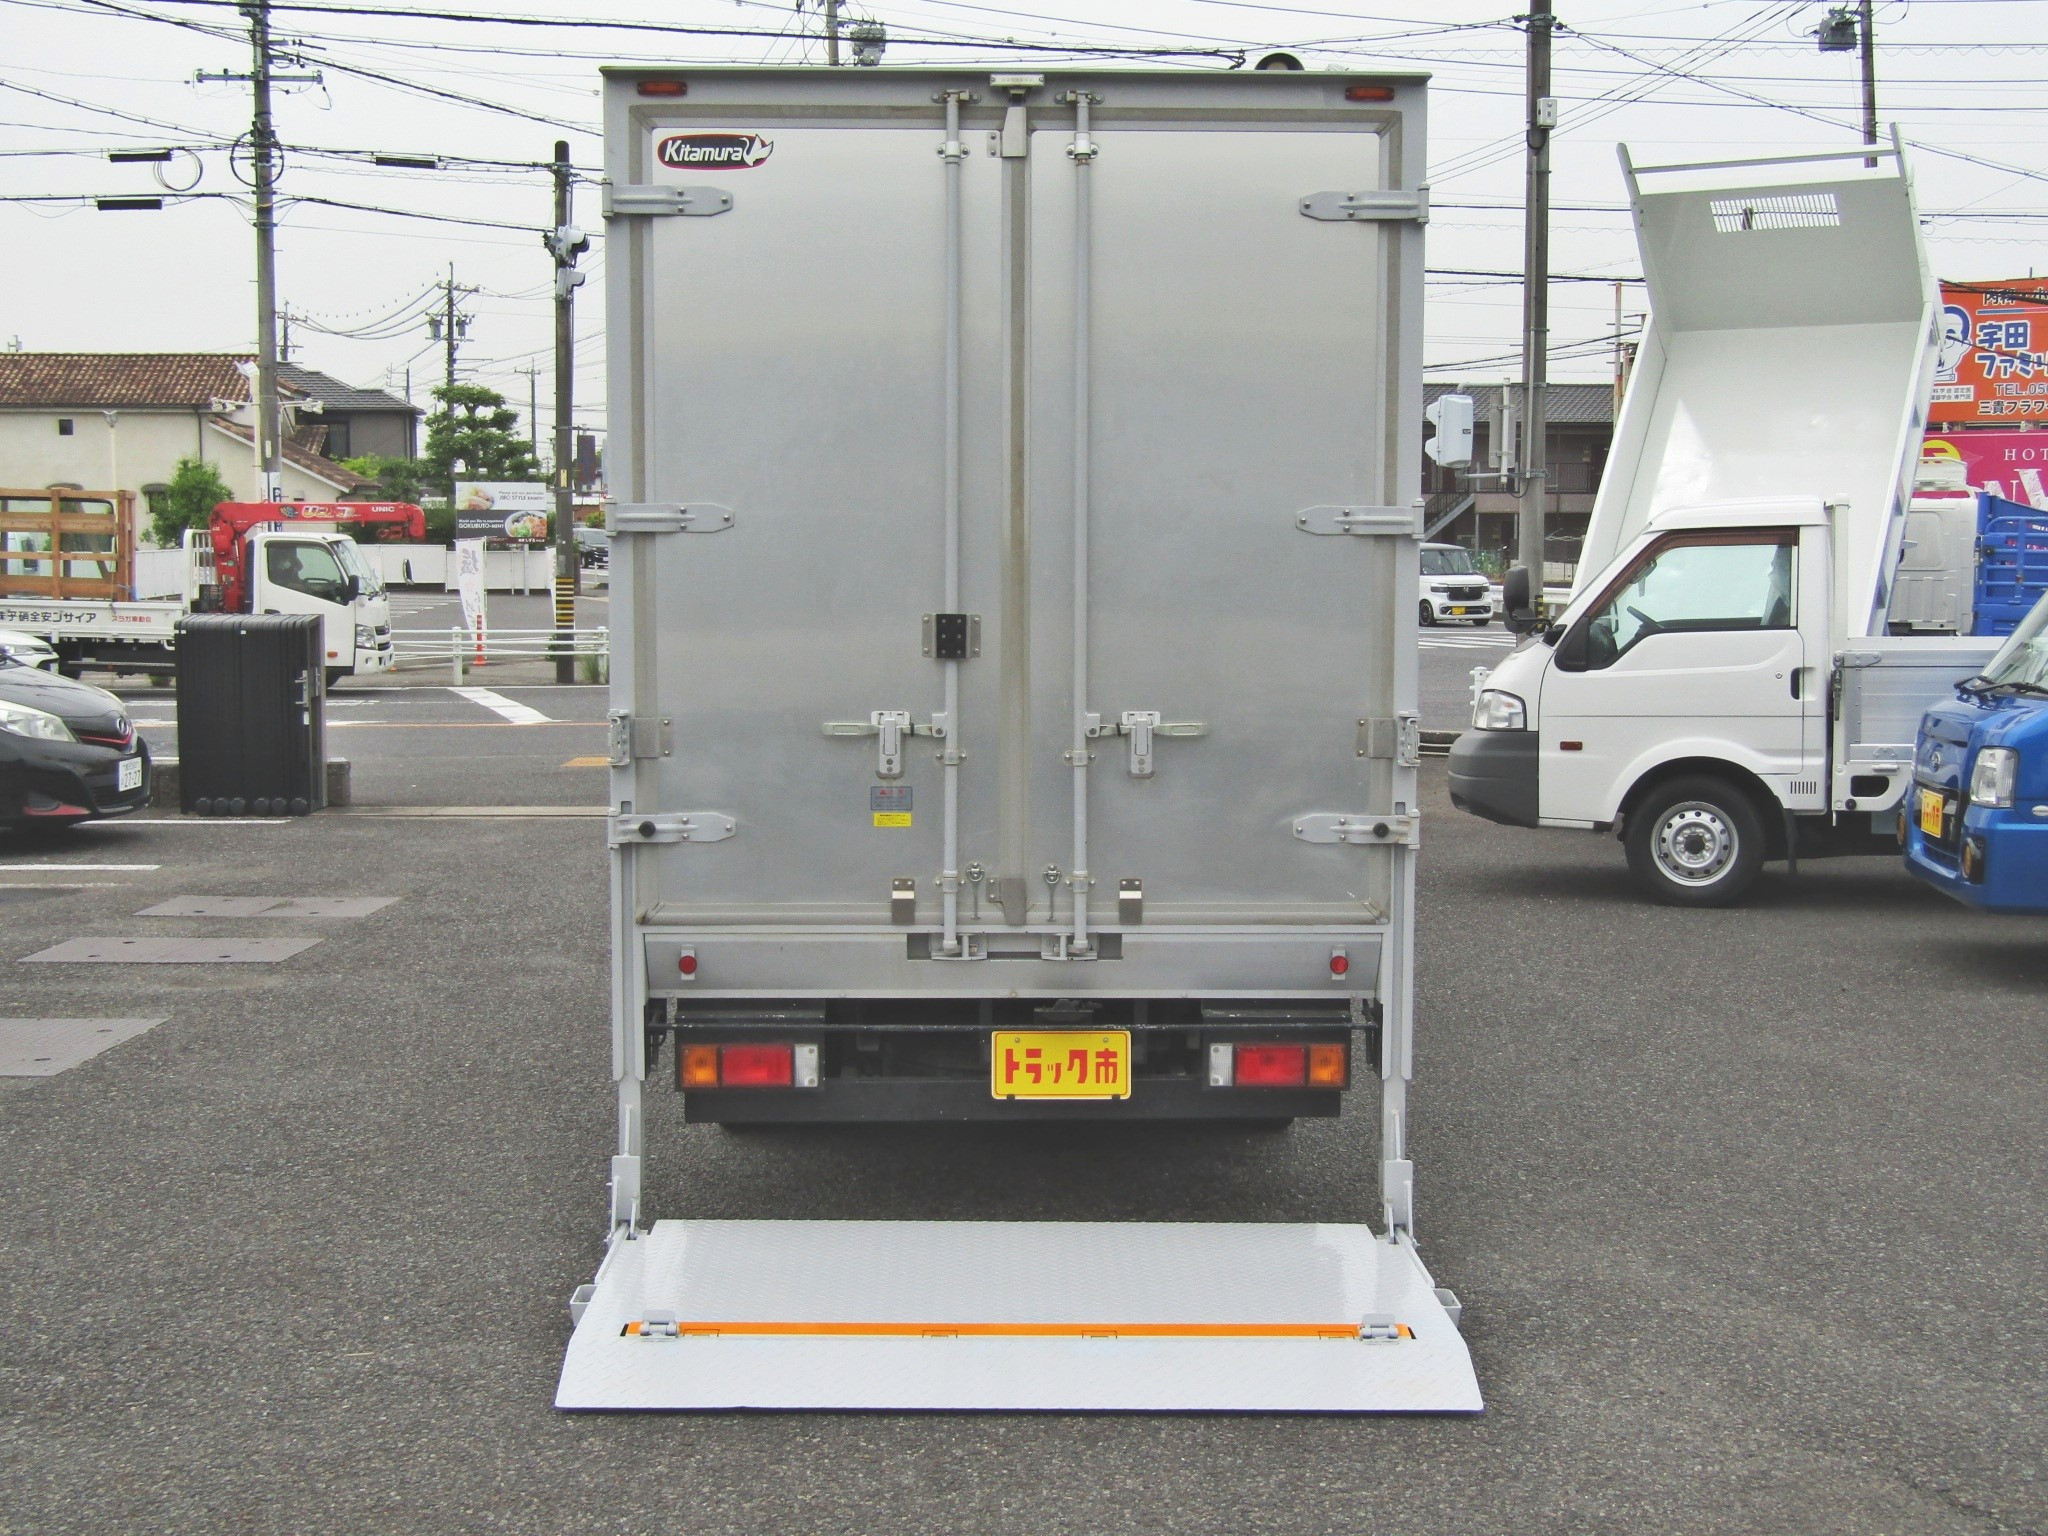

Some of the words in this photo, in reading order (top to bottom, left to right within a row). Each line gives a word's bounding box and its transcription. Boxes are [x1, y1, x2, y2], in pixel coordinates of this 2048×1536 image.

[664, 139, 743, 162] Kitamura
[1977, 321, 2029, 350] 宇田
[1995, 383, 2048, 396] TEL.05
[1978, 400, 2048, 415] 三貴フラワ
[1005, 1047, 1118, 1084] トラック市
